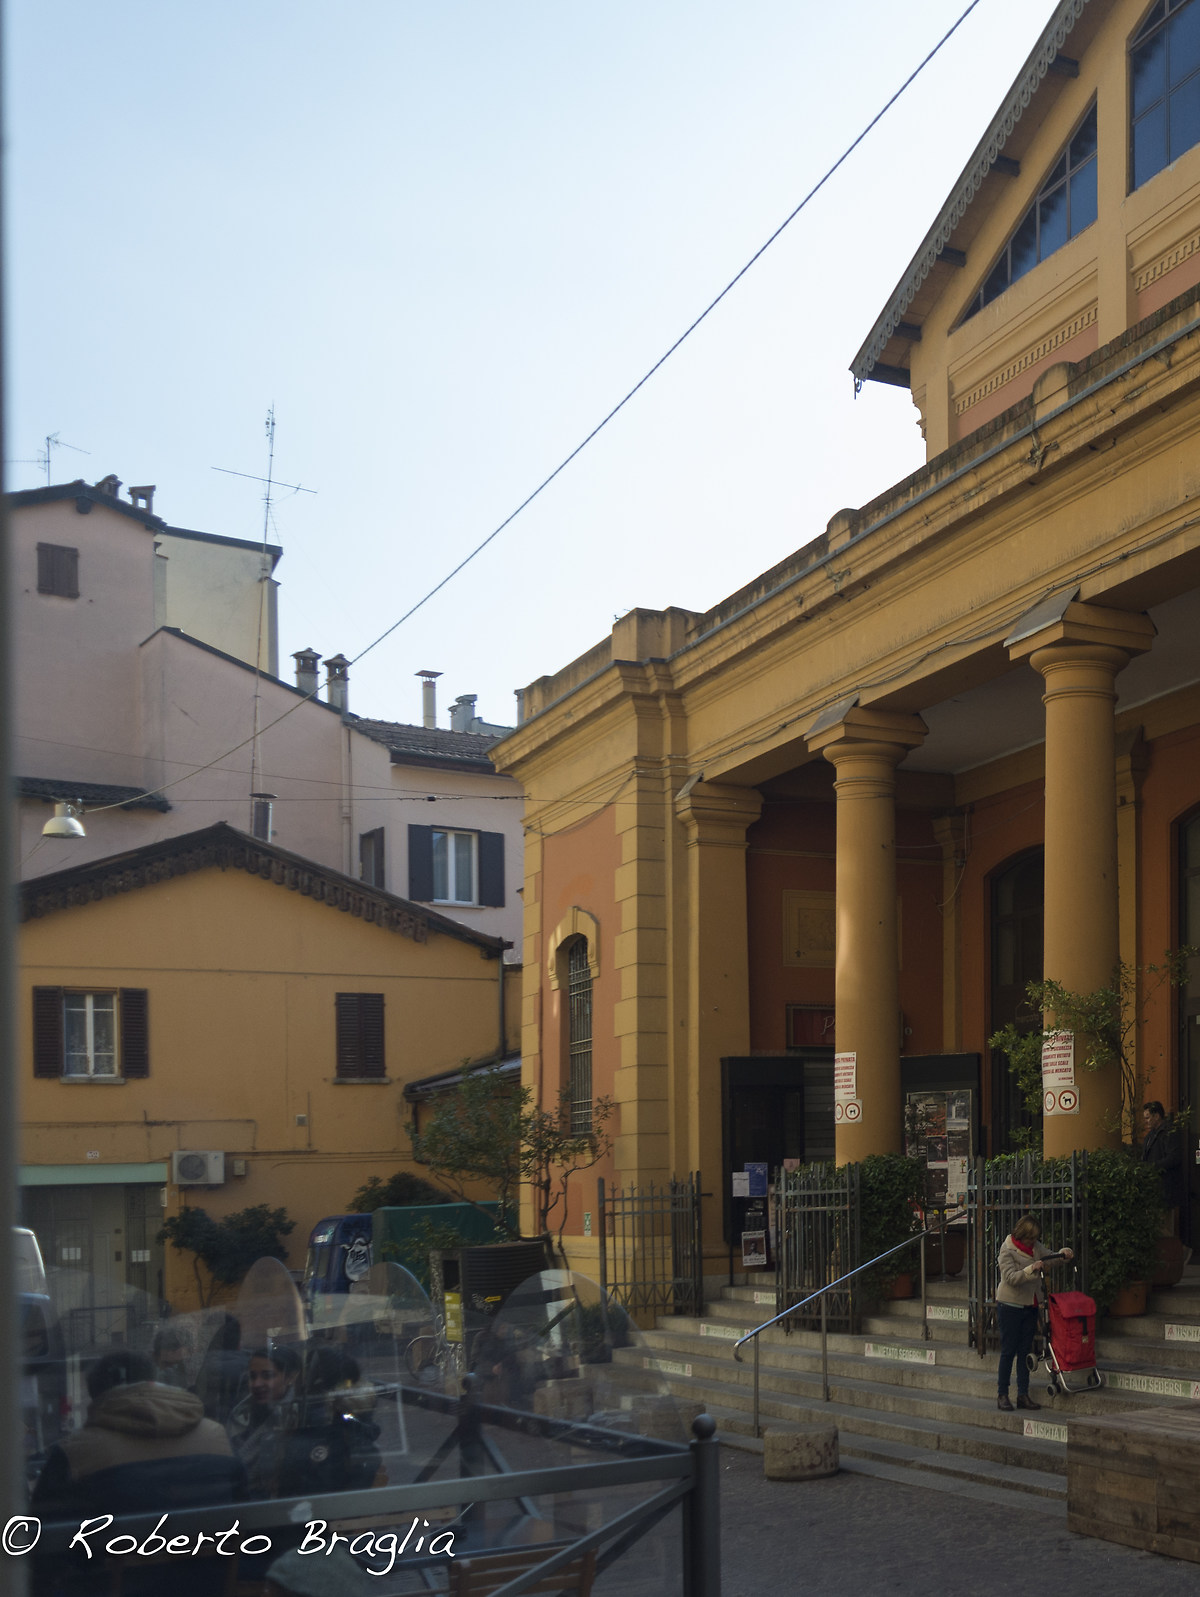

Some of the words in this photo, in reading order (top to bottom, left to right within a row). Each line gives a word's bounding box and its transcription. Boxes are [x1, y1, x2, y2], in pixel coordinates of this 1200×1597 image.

[1176, 1327, 1200, 1341] USCITA
[1117, 1376, 1147, 1392] VIETATO
[1148, 1379, 1182, 1397] SEDERSI
[1035, 1422, 1060, 1440] USCITA
